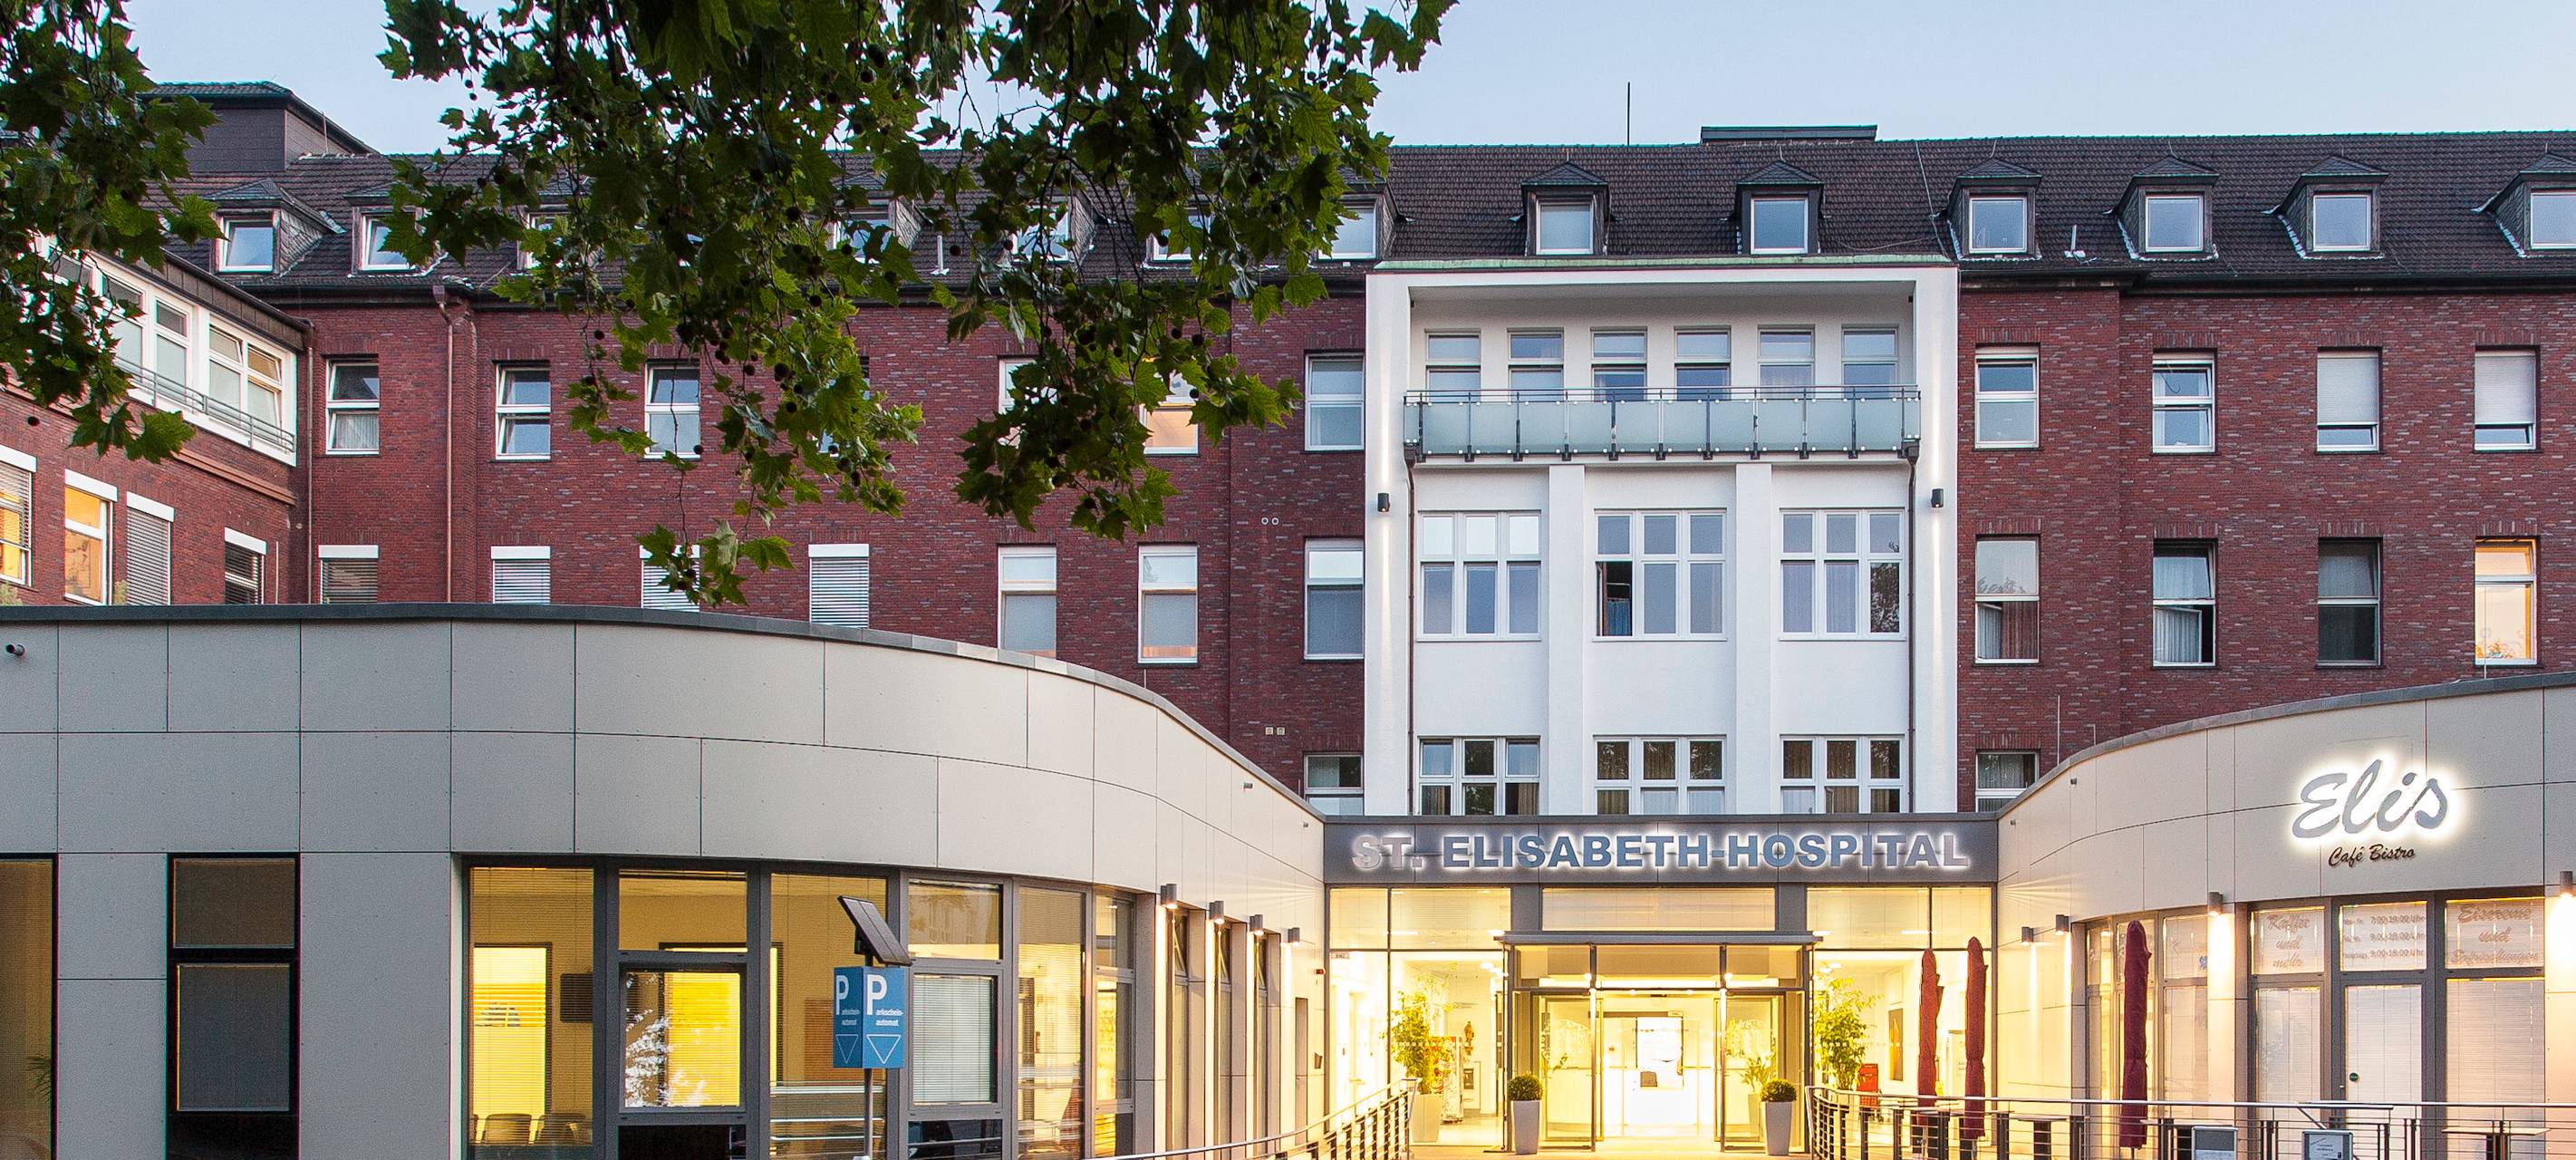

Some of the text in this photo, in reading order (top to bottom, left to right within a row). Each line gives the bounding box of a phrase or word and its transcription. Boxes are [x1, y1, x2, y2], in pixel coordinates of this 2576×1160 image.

[2291, 759, 2448, 838] Elis
[1352, 834, 1969, 869] ST. ELISABETH-HOSPITAL
[2328, 843, 2417, 868] Café Bistro
[2267, 914, 2310, 933] Kaffee
[2478, 926, 2513, 942] und
[2275, 934, 2303, 950] und
[2272, 952, 2304, 968] mehr
[835, 974, 850, 1016] P
[866, 973, 888, 1016] P
